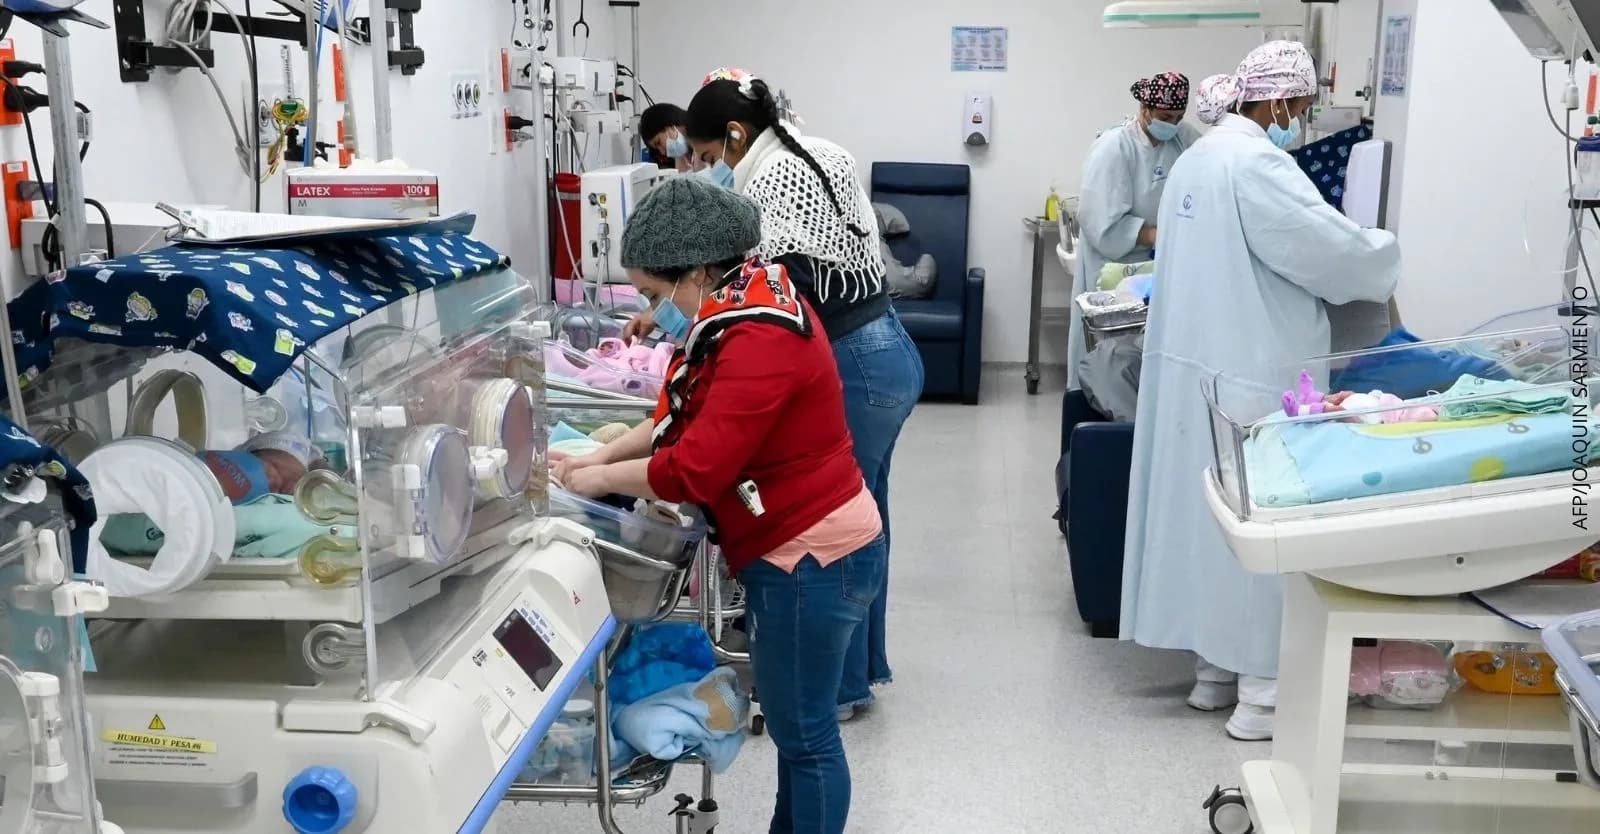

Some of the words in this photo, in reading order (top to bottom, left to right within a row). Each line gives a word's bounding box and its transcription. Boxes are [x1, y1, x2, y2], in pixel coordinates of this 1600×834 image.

[296, 186, 331, 196] LATEX
[407, 185, 423, 194] 100
[297, 199, 308, 207] M
[117, 733, 160, 745] HUMEDAD
[162, 738, 167, 746] Y
[170, 740, 191, 749] PESA
